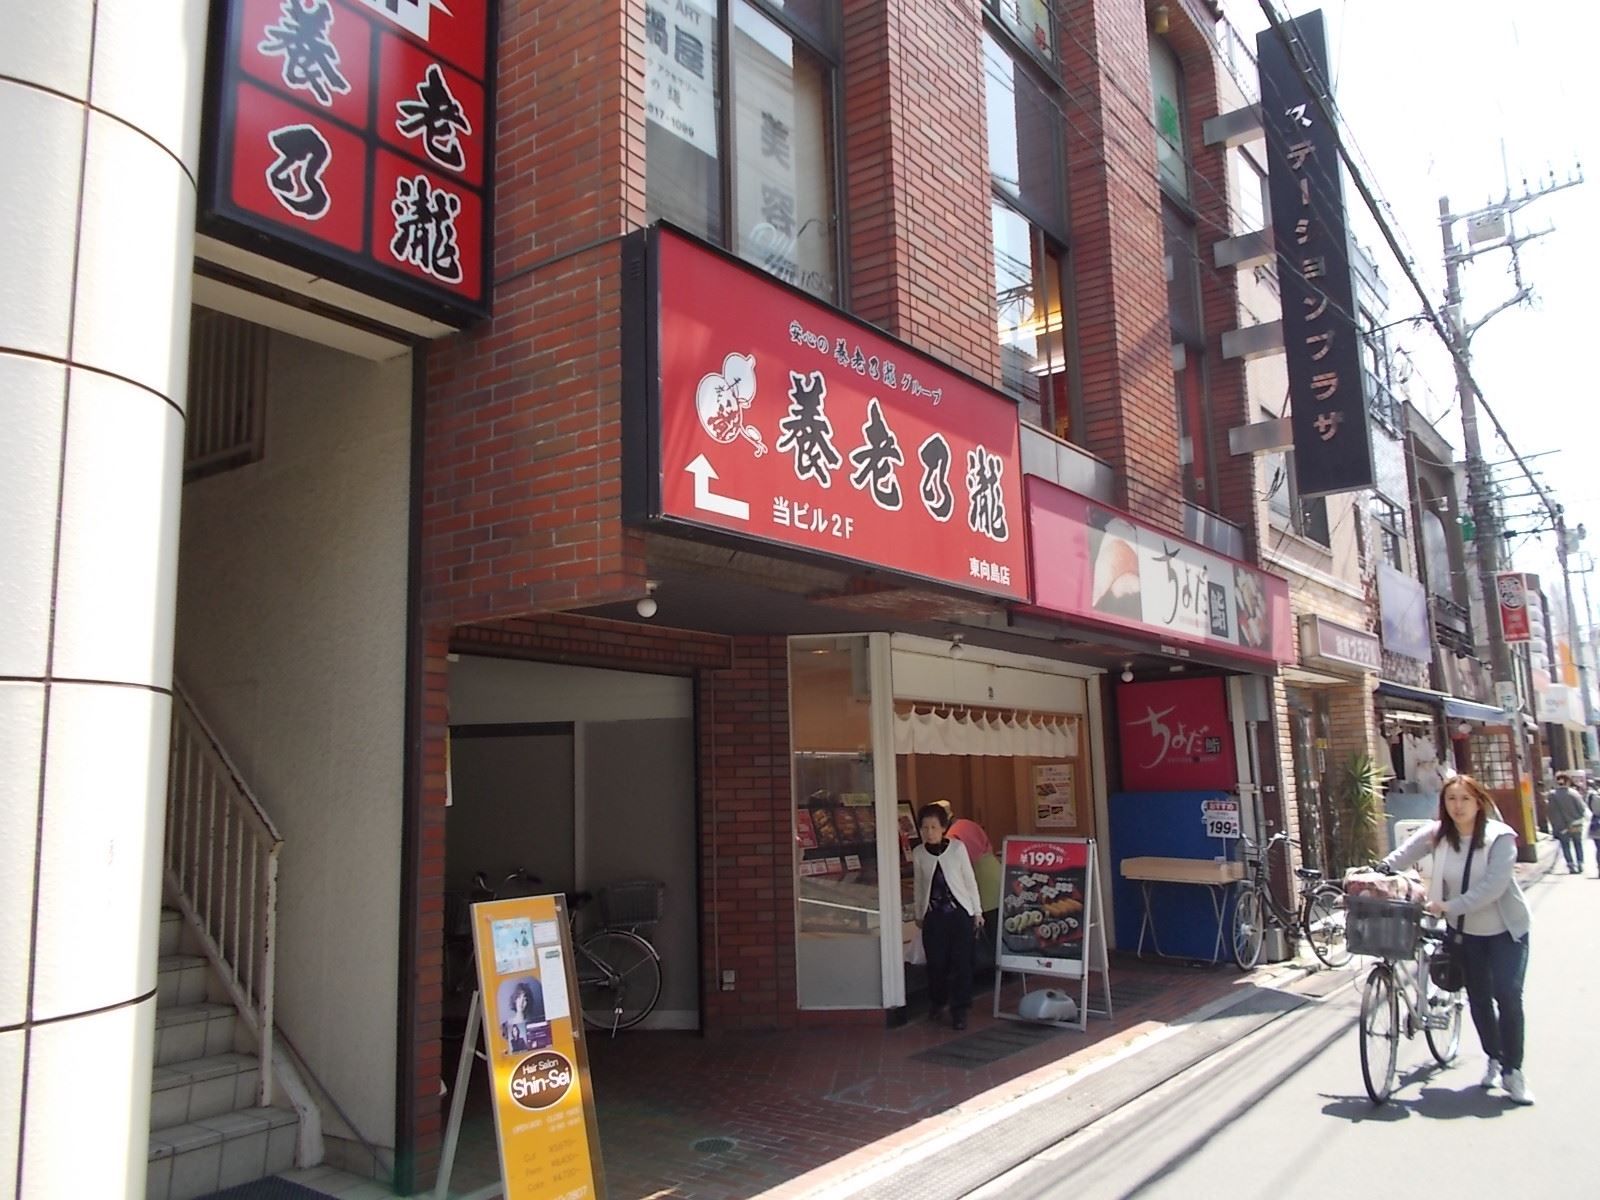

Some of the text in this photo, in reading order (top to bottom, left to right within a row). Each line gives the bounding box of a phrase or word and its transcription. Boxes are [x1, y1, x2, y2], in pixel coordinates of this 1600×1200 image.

[776, 370, 1009, 542] 養老乃瀧
[969, 556, 1011, 586] 東向島店
[522, 1058, 559, 1075] Hair Salon
[512, 1067, 571, 1099] Shin-Sei
